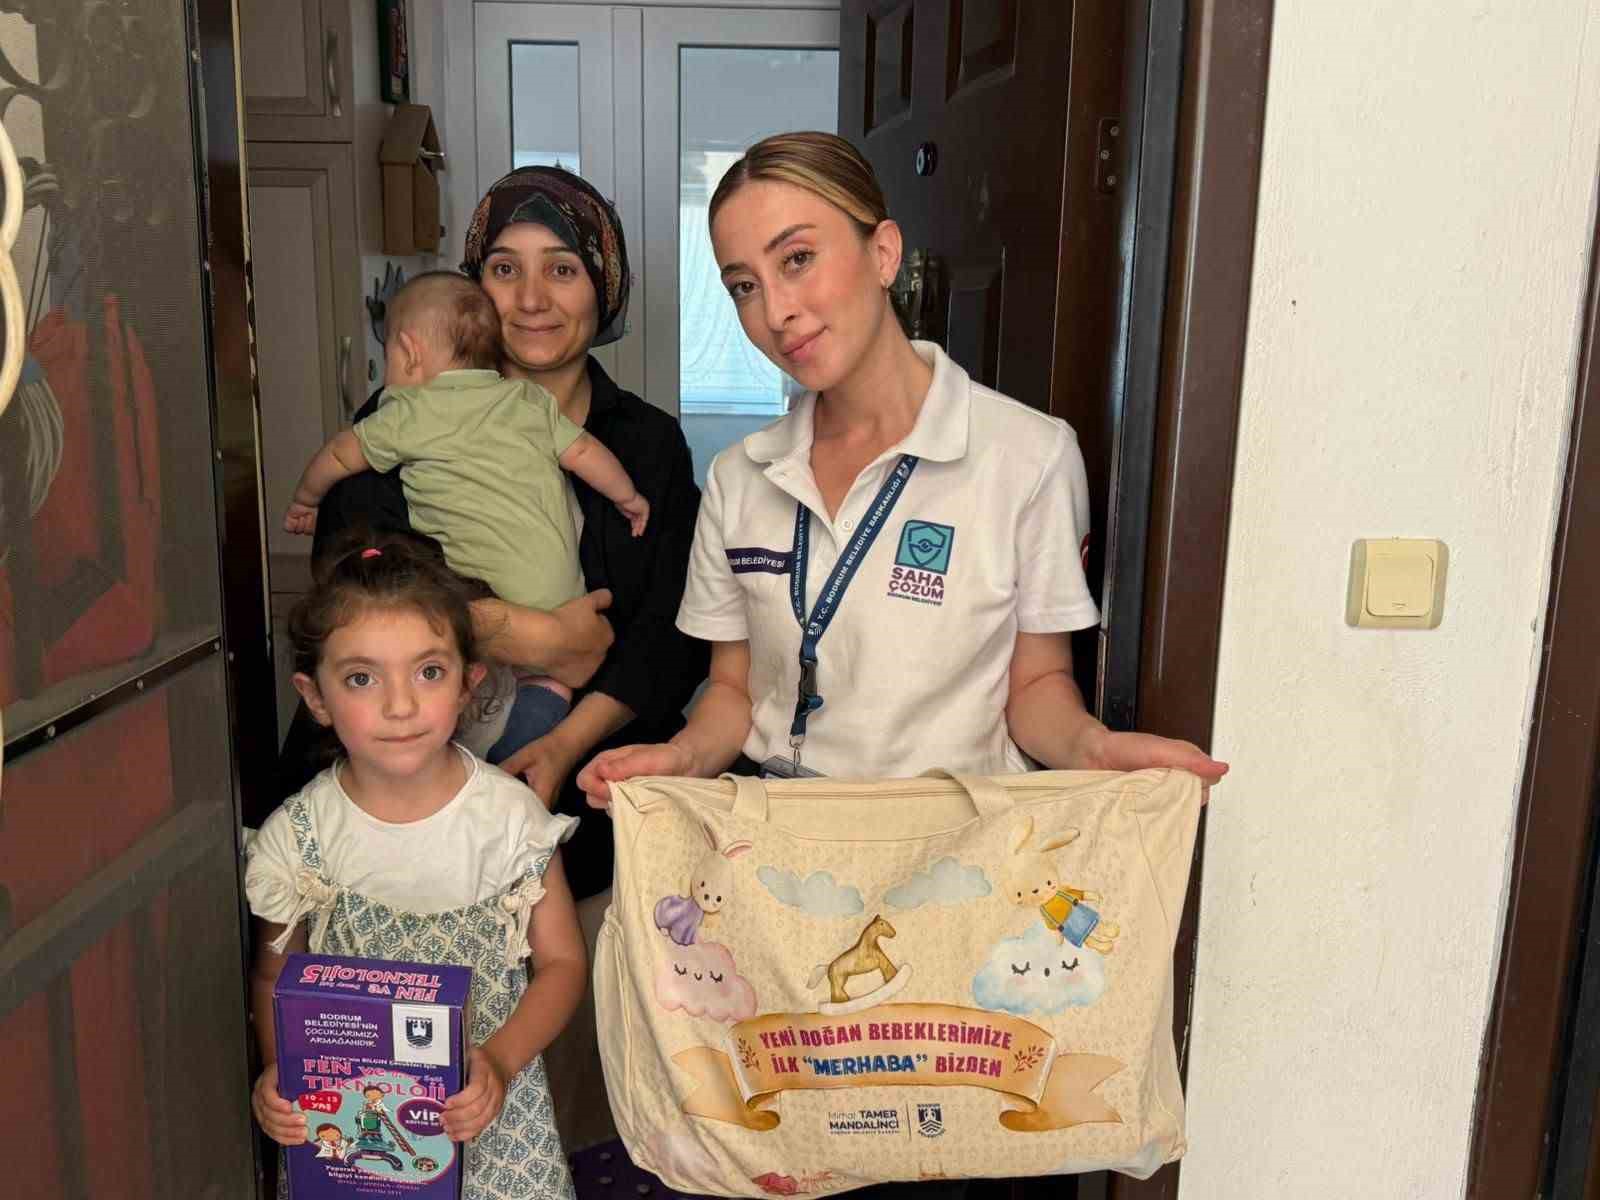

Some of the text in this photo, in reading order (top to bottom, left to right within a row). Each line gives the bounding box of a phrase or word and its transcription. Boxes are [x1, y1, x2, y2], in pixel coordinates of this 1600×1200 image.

[825, 566, 849, 604] BODRUM
[891, 567, 945, 589] SAHA
[394, 985, 438, 1002] FEN
[320, 1013, 362, 1021] BODRUM
[305, 1028, 379, 1038] ÇOCUKLARIMIZA
[759, 1020, 1012, 1050] YENİ DOĞAN BEBEKLERİMİZE
[303, 1059, 352, 1075] FEN
[772, 1053, 800, 1074] İLK
[935, 1052, 1002, 1077] BİZDEN
[860, 1110, 898, 1119] TAMER
